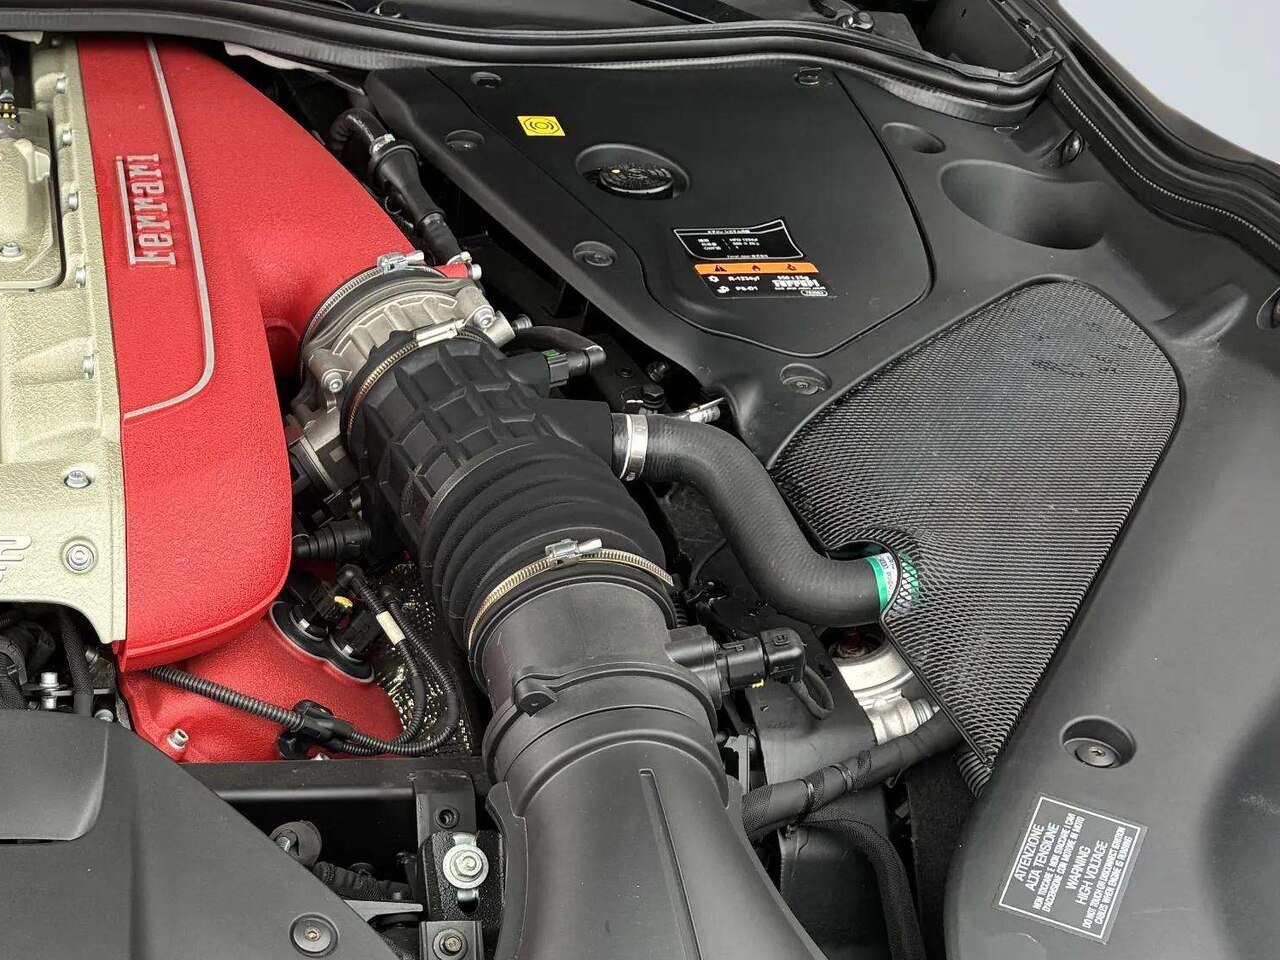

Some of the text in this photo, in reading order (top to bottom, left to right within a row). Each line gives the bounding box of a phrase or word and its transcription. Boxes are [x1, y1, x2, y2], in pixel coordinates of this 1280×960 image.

[116, 153, 176, 267] Ferrari
[1013, 823, 1045, 882] ATTENZIONE
[1024, 822, 1060, 891] ALTA TENSIONE
[1065, 845, 1091, 891] WARNING
[1075, 839, 1108, 905] HIGH VOLTAGE
